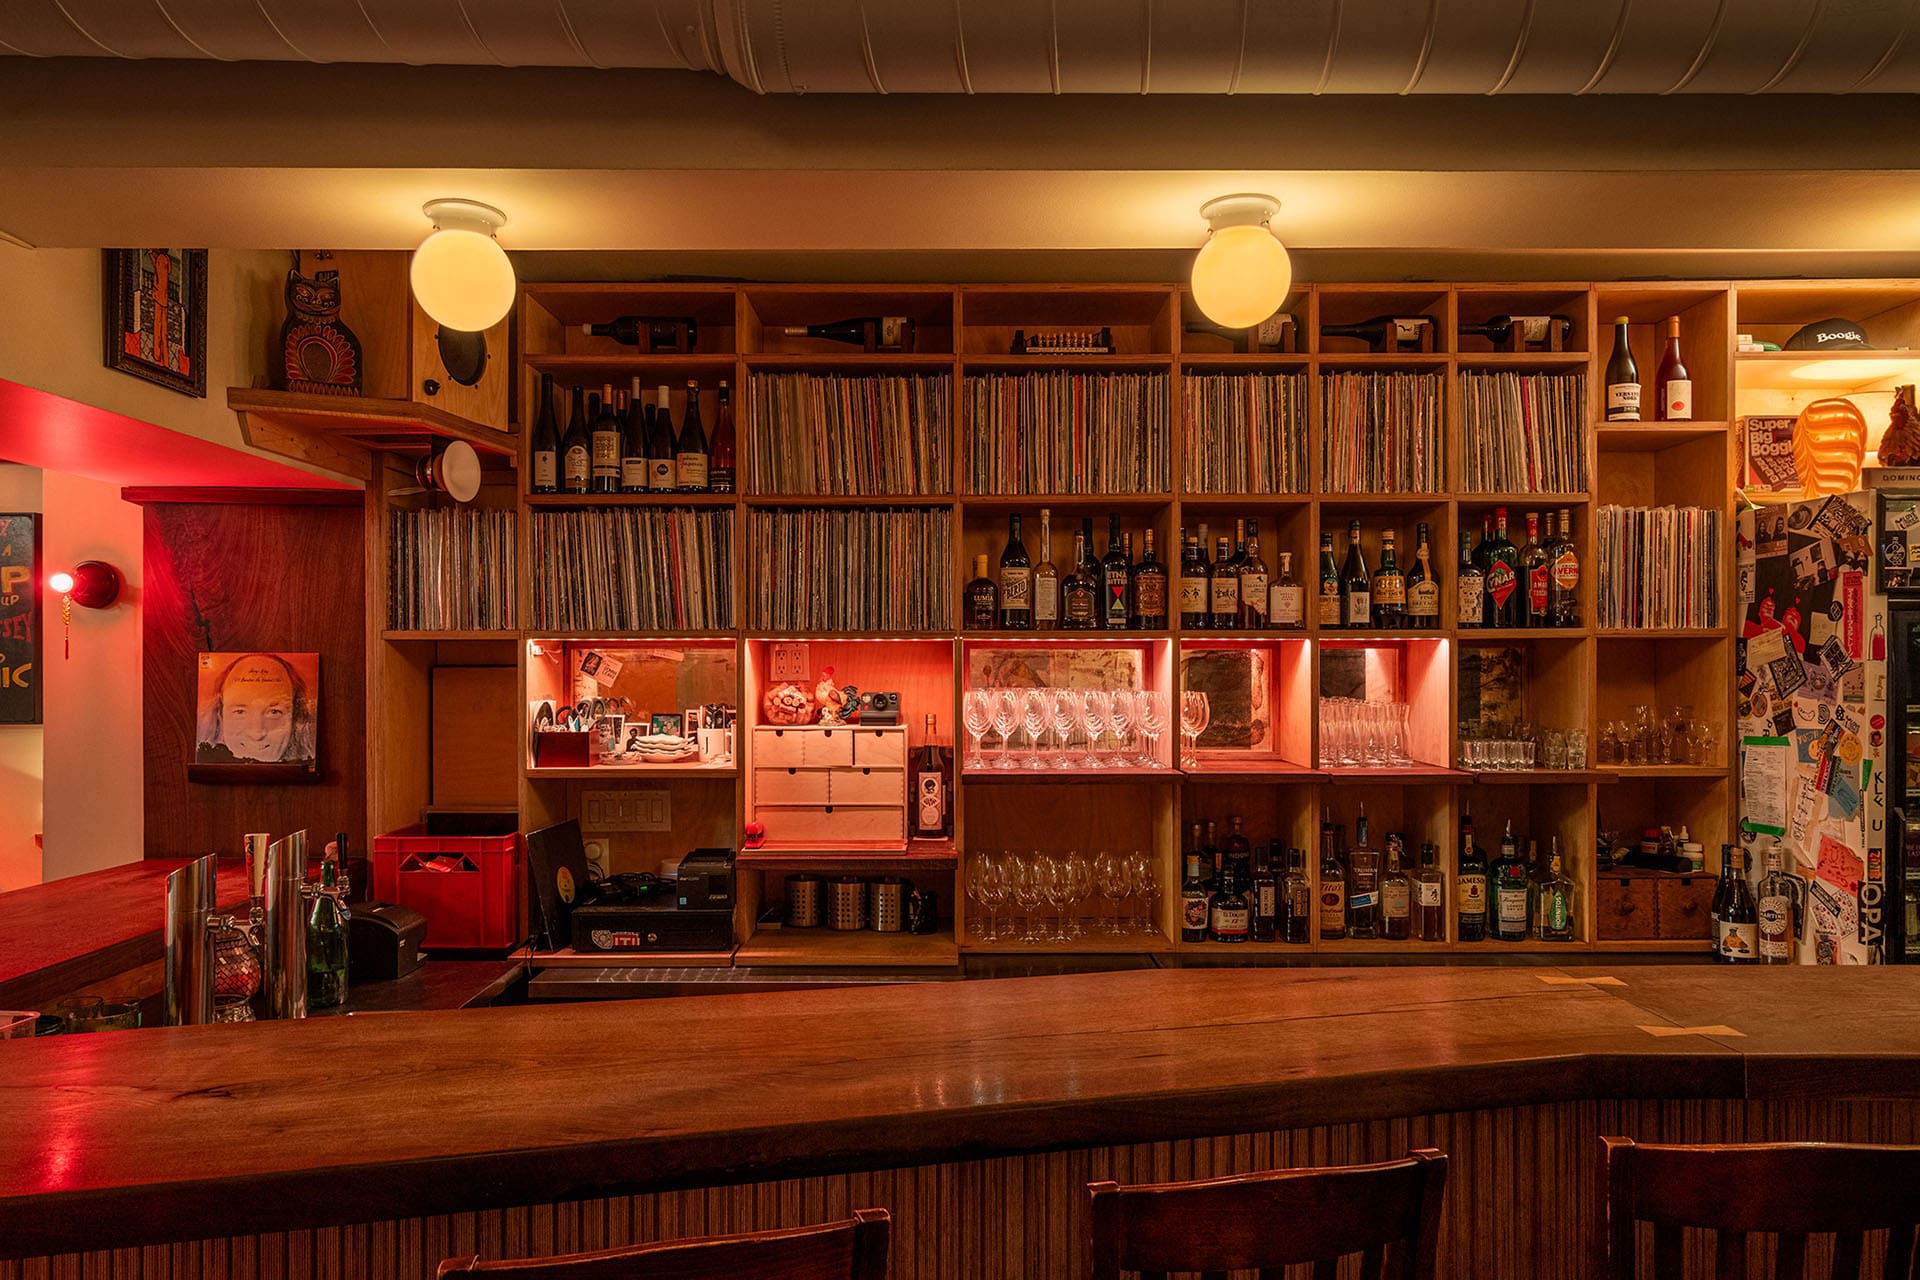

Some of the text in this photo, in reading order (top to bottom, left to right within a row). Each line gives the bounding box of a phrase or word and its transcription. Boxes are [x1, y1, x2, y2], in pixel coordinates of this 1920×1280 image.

[1749, 419, 1791, 431] Super
[1750, 431, 1773, 444] Big
[1751, 441, 1793, 457] Boggl
[1457, 877, 1485, 885] JAMESO
